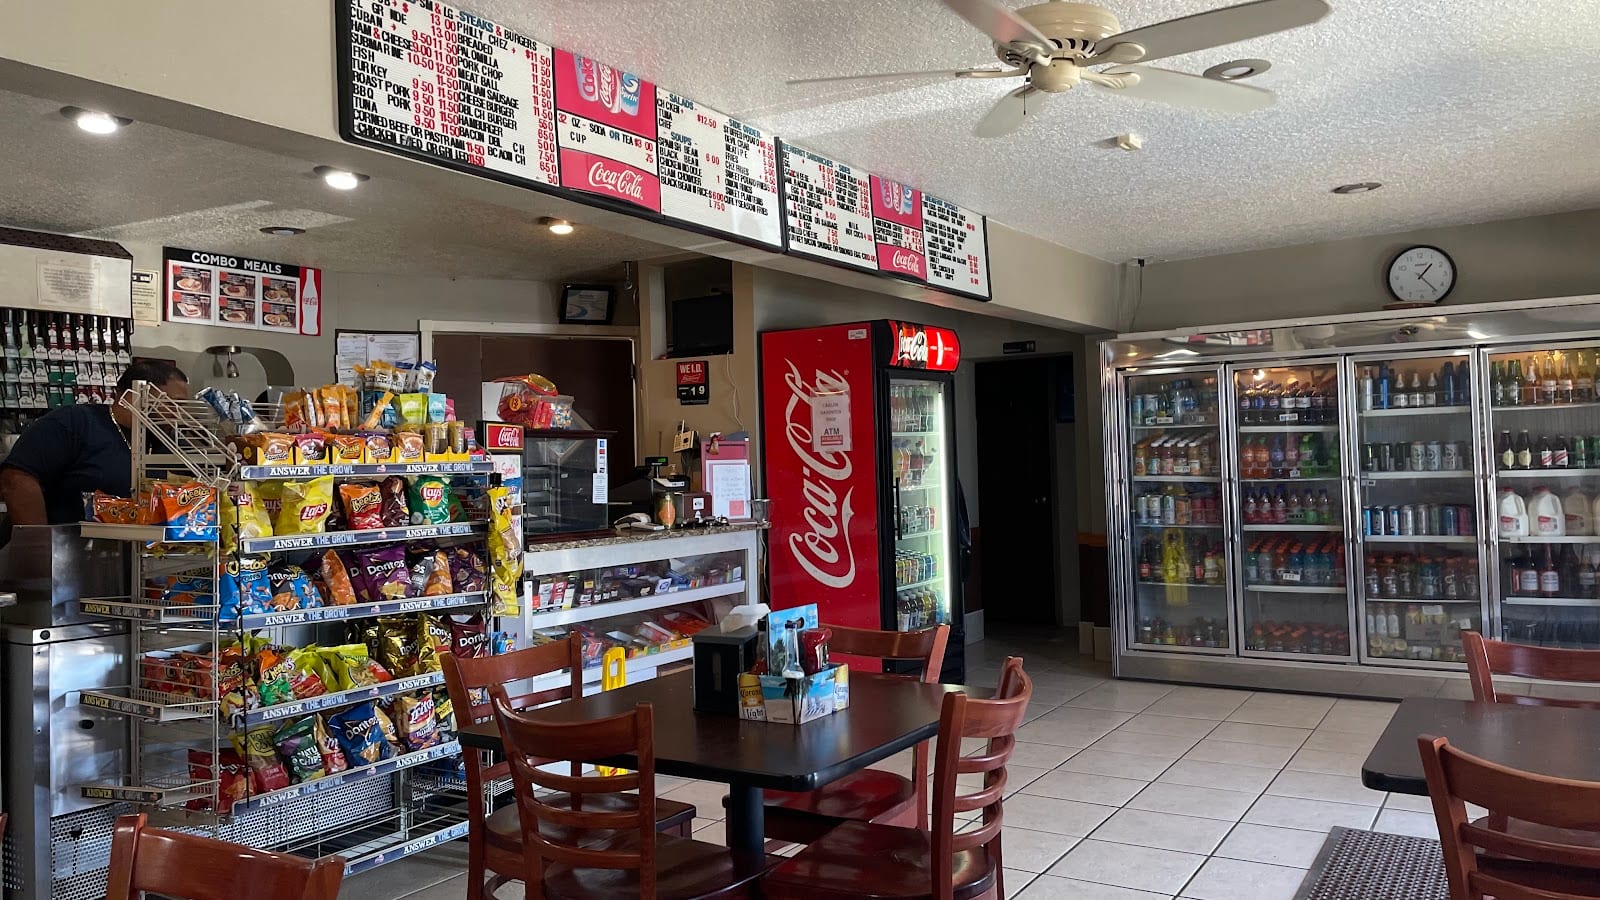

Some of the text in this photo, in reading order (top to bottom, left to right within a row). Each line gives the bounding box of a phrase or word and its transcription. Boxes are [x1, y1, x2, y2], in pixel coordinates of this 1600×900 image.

[351, 7, 382, 28] CUBAN
[434, 2, 441, 14] &
[443, 5, 453, 19] LG
[351, 19, 371, 36] HAM
[373, 27, 380, 38] &
[381, 30, 413, 51] CHEESE
[457, 21, 507, 50] PHILLY CHEZ
[459, 10, 536, 51] STEAKS & BURGERS
[353, 45, 374, 62] FISH
[457, 33, 492, 56] BREADED
[353, 57, 387, 79] TURKEY
[457, 56, 479, 73] PORK
[481, 64, 503, 82] CHOP
[353, 70, 383, 90] ROAST
[385, 80, 410, 99] PORK
[458, 68, 499, 91] MEAT BALL
[353, 83, 373, 100] BBQ
[387, 94, 410, 111] PORK
[354, 96, 377, 113] TUNA
[458, 79, 519, 109] ITALIAN SAUSAGE
[669, 93, 693, 110] SALADS
[458, 103, 517, 131] DBL CH BURGER
[458, 114, 503, 137] HAMBURGER
[658, 117, 671, 130] CHEF
[354, 109, 387, 128] CORNED
[389, 118, 408, 134] BEEF
[410, 125, 423, 138] OR
[424, 129, 465, 150] PASTRAMI
[358, 122, 396, 143] CHICKEN
[459, 126, 484, 143] BACON
[488, 135, 502, 148] DBL
[558, 114, 634, 146] 32 OZ SODA OR TEA
[570, 132, 587, 144] CUP
[671, 131, 692, 146] SOUPS
[515, 154, 525, 165] CH
[659, 146, 698, 166] BLACK BEAN
[588, 161, 644, 200] Coca-Cola
[660, 165, 701, 186] CLAM CHOWDER
[192, 252, 282, 274] COMBO MEALS
[898, 329, 928, 361] Coca-Cola
[680, 364, 690, 374] WE
[824, 428, 840, 436] ATM
[270, 466, 354, 476] ANSWER THE GROWL
[406, 463, 474, 472] ANSWER THE GROWL
[177, 486, 210, 506] Cheetos
[274, 535, 357, 549] ANSWER THE GROWL
[406, 526, 472, 538] ANSWER THE GROWL
[366, 560, 405, 576] Doritos
[84, 603, 110, 614] ANSWER
[400, 596, 468, 610] ANSWER THE GROWL
[265, 608, 350, 626] ANSWER THE GROWL
[398, 678, 432, 690] ANSWER
[84, 694, 109, 708] ANSWER
[263, 695, 348, 720] ANSWER THE GROWL
[346, 716, 382, 740] Doritos
[396, 748, 444, 768] ANSWER THE
[86, 788, 112, 799] ANSWER
[259, 776, 346, 808] ANSWER THE GROWL
[404, 832, 450, 855] ANSWER THE
